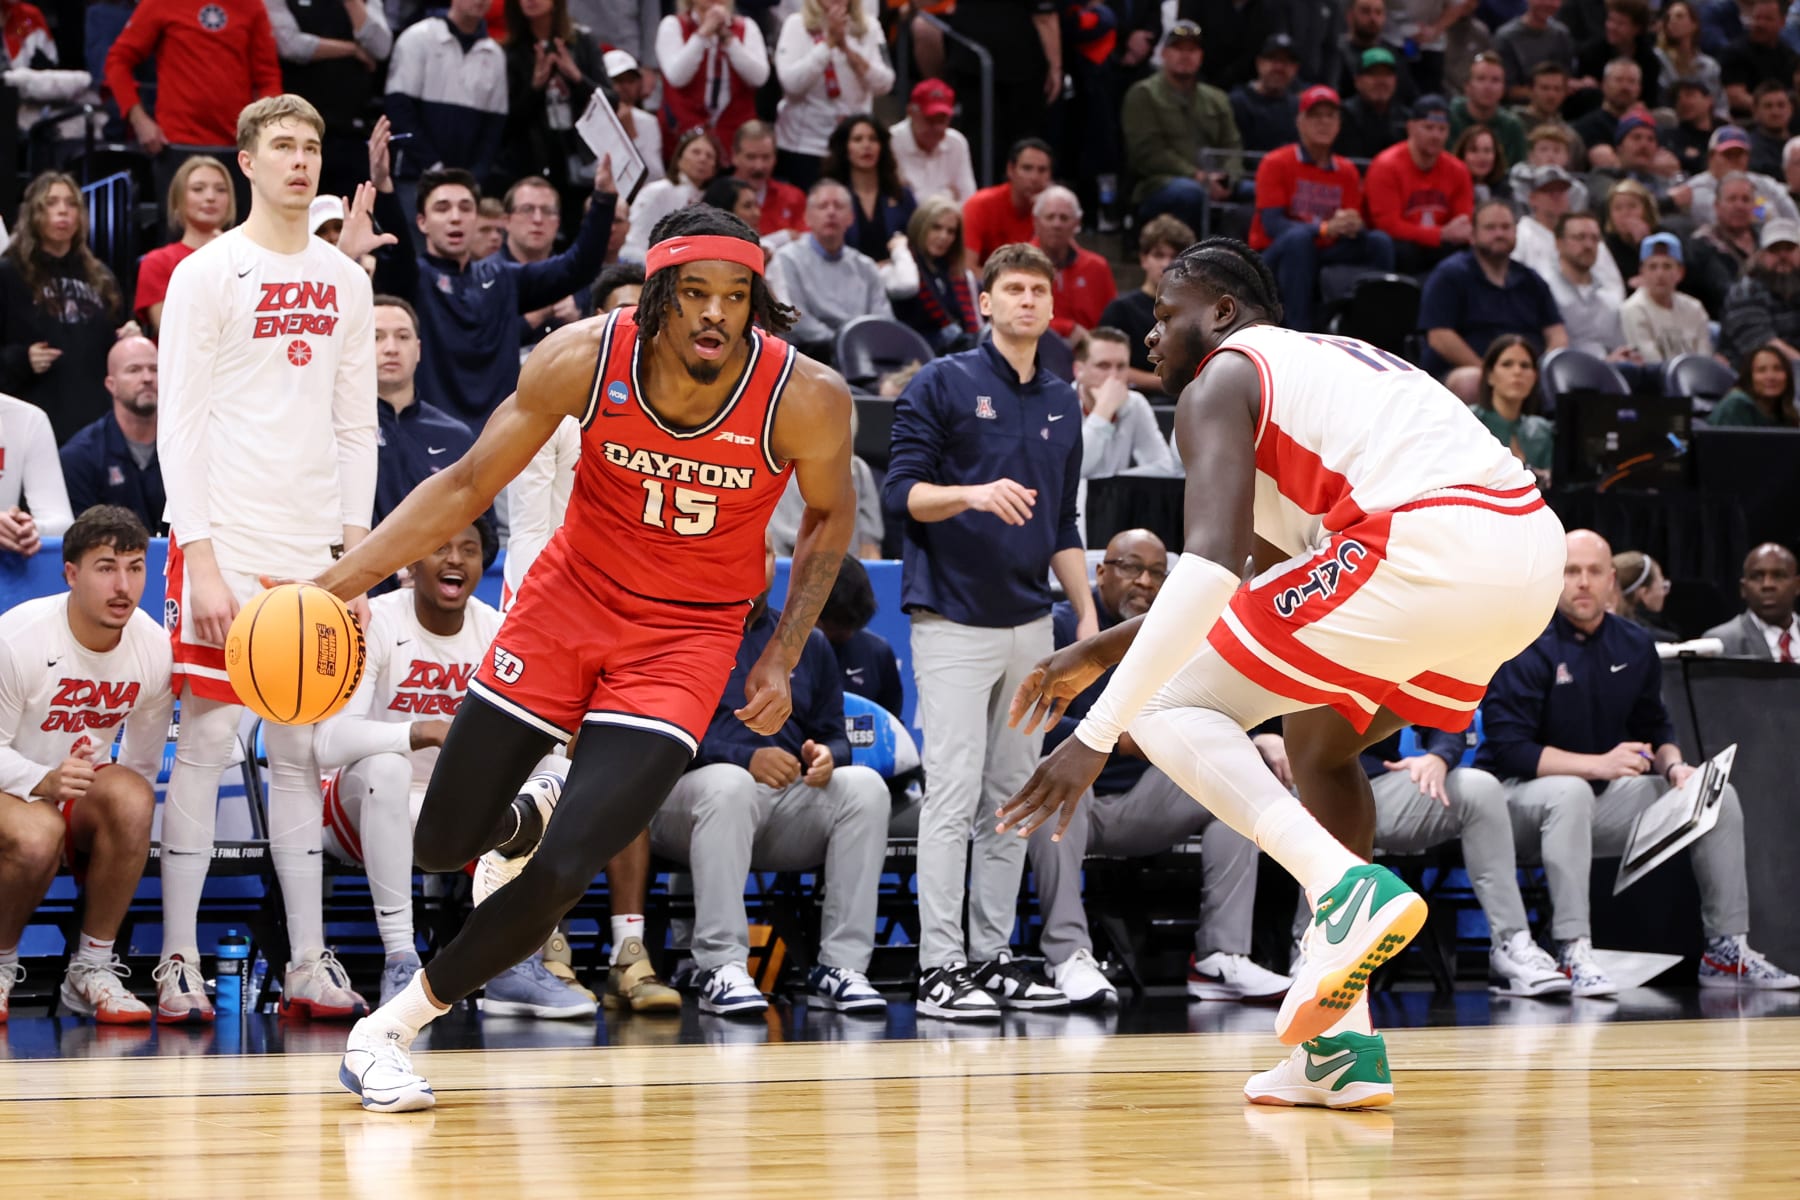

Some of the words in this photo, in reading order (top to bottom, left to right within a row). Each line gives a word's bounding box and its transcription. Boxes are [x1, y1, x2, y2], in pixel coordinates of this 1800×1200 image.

[254, 281, 339, 313] ZONA
[252, 314, 339, 339] ENERGY
[609, 390, 627, 402] NCAA
[975, 395, 997, 419] A
[602, 441, 755, 488] DAYTON
[641, 478, 719, 536] 15
[1273, 539, 1368, 618] CATS
[398, 659, 479, 692] ZON
[50, 678, 141, 709] ZONA
[40, 709, 131, 733] ENERGY
[218, 848, 240, 859] FINAL
[242, 848, 264, 858] FOUR
